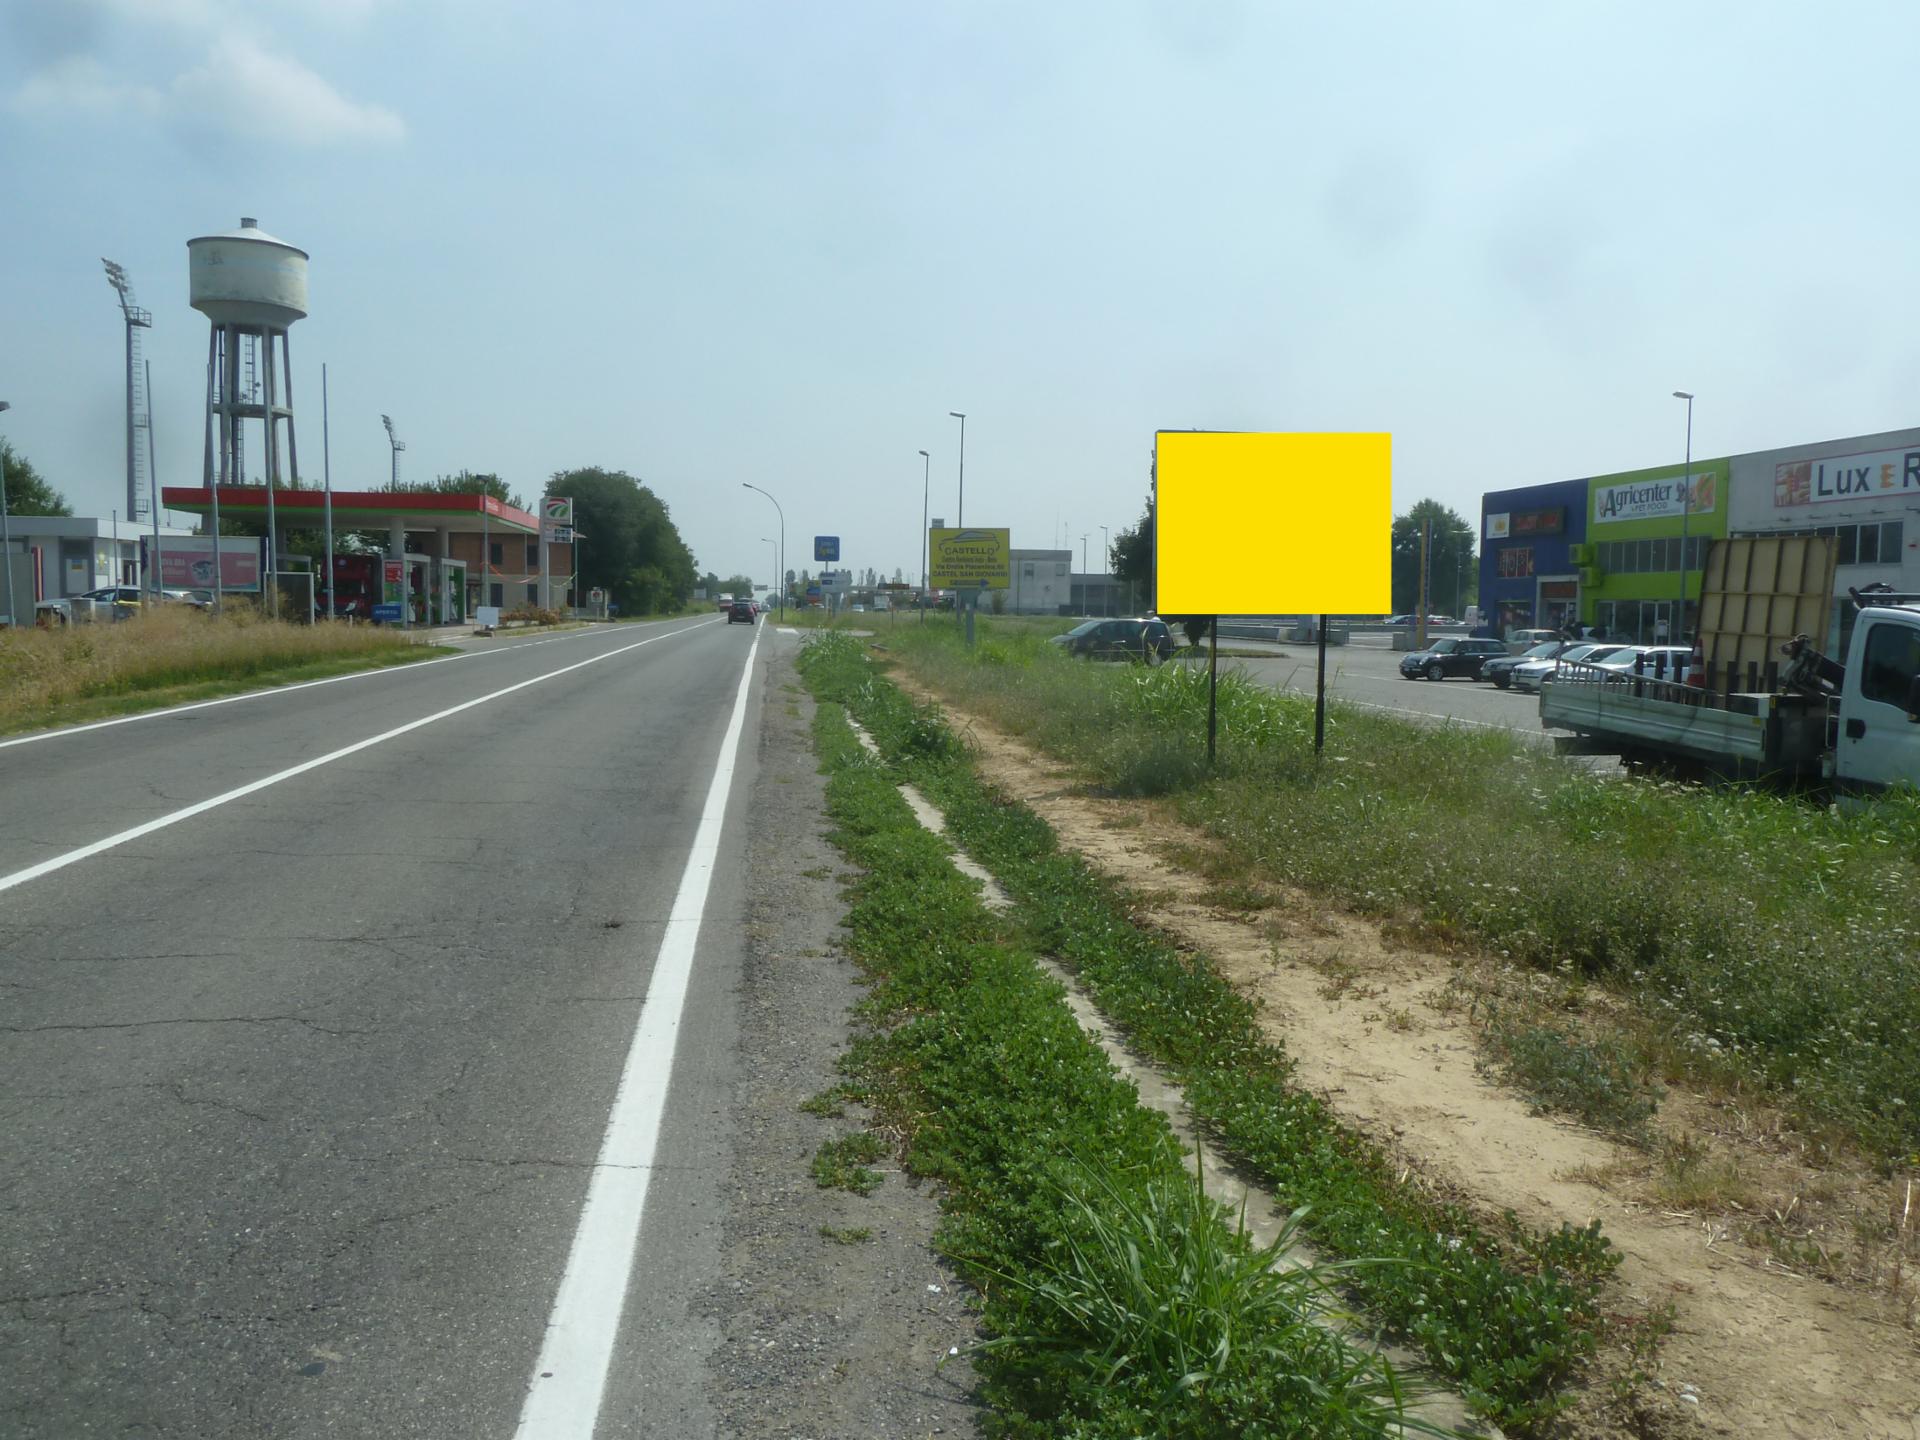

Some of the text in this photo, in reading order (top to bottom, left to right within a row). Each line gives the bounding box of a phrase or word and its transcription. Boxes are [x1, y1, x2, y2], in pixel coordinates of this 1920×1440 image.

[1818, 464, 1871, 496] Lux
[1603, 483, 1672, 518] Agricenter
[944, 547, 994, 555] CASTELLO
